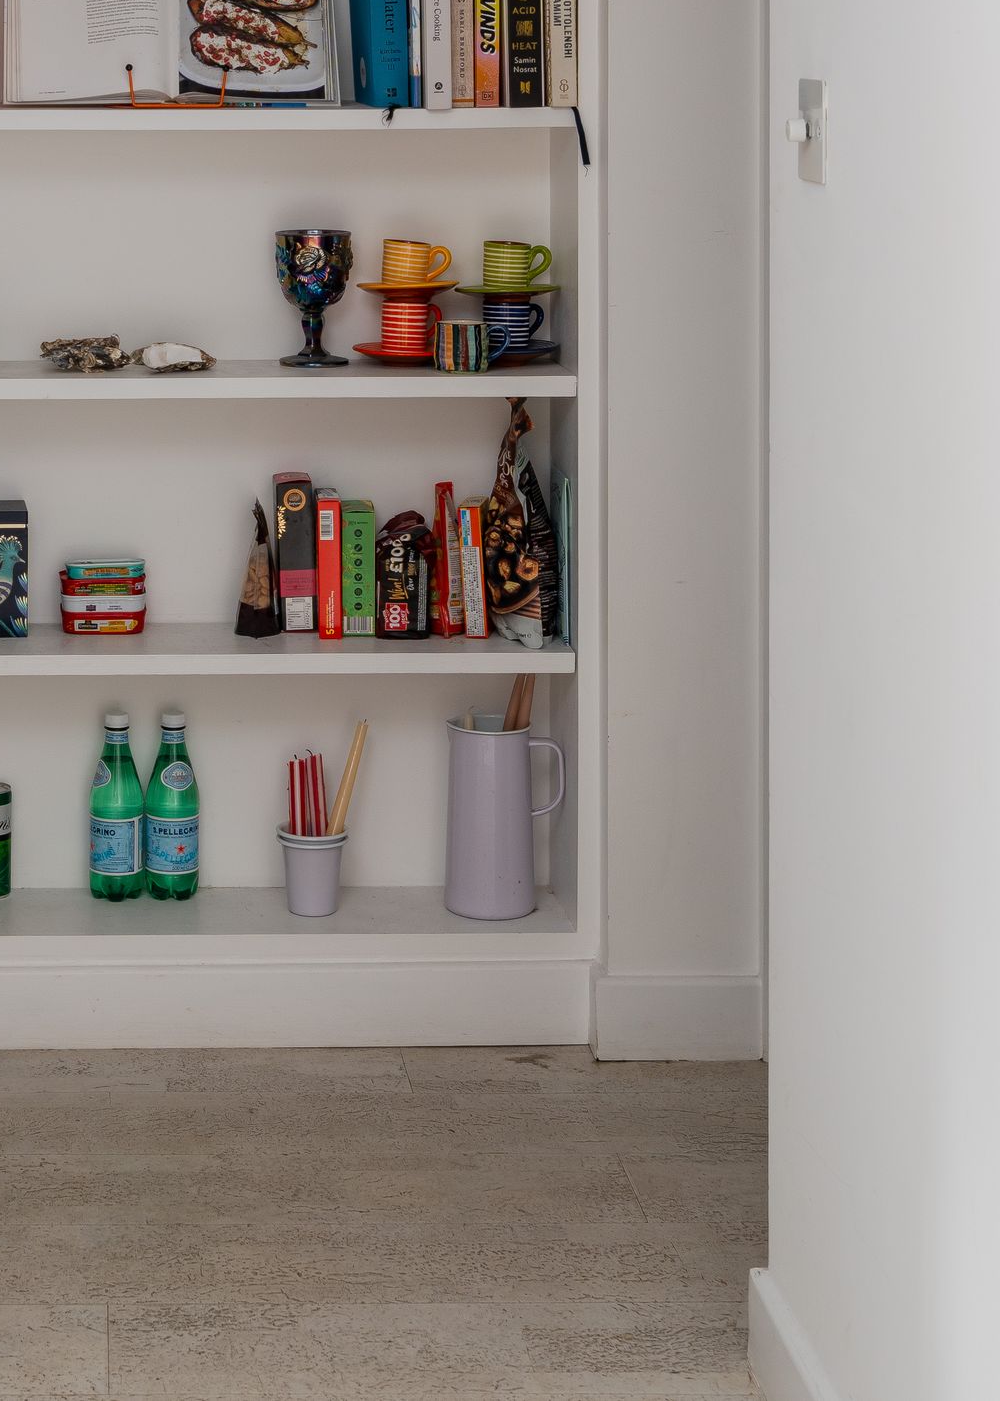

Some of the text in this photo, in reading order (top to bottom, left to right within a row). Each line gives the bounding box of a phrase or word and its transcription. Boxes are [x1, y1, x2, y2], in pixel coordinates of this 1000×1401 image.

[512, 7, 537, 15] ACID
[432, 9, 442, 42] Cooking
[563, 1, 573, 58] OTTOLENGHI
[511, 41, 538, 51] HEAT
[514, 56, 536, 64] Samin
[387, 577, 406, 600] Win!
[389, 604, 401, 629] 100
